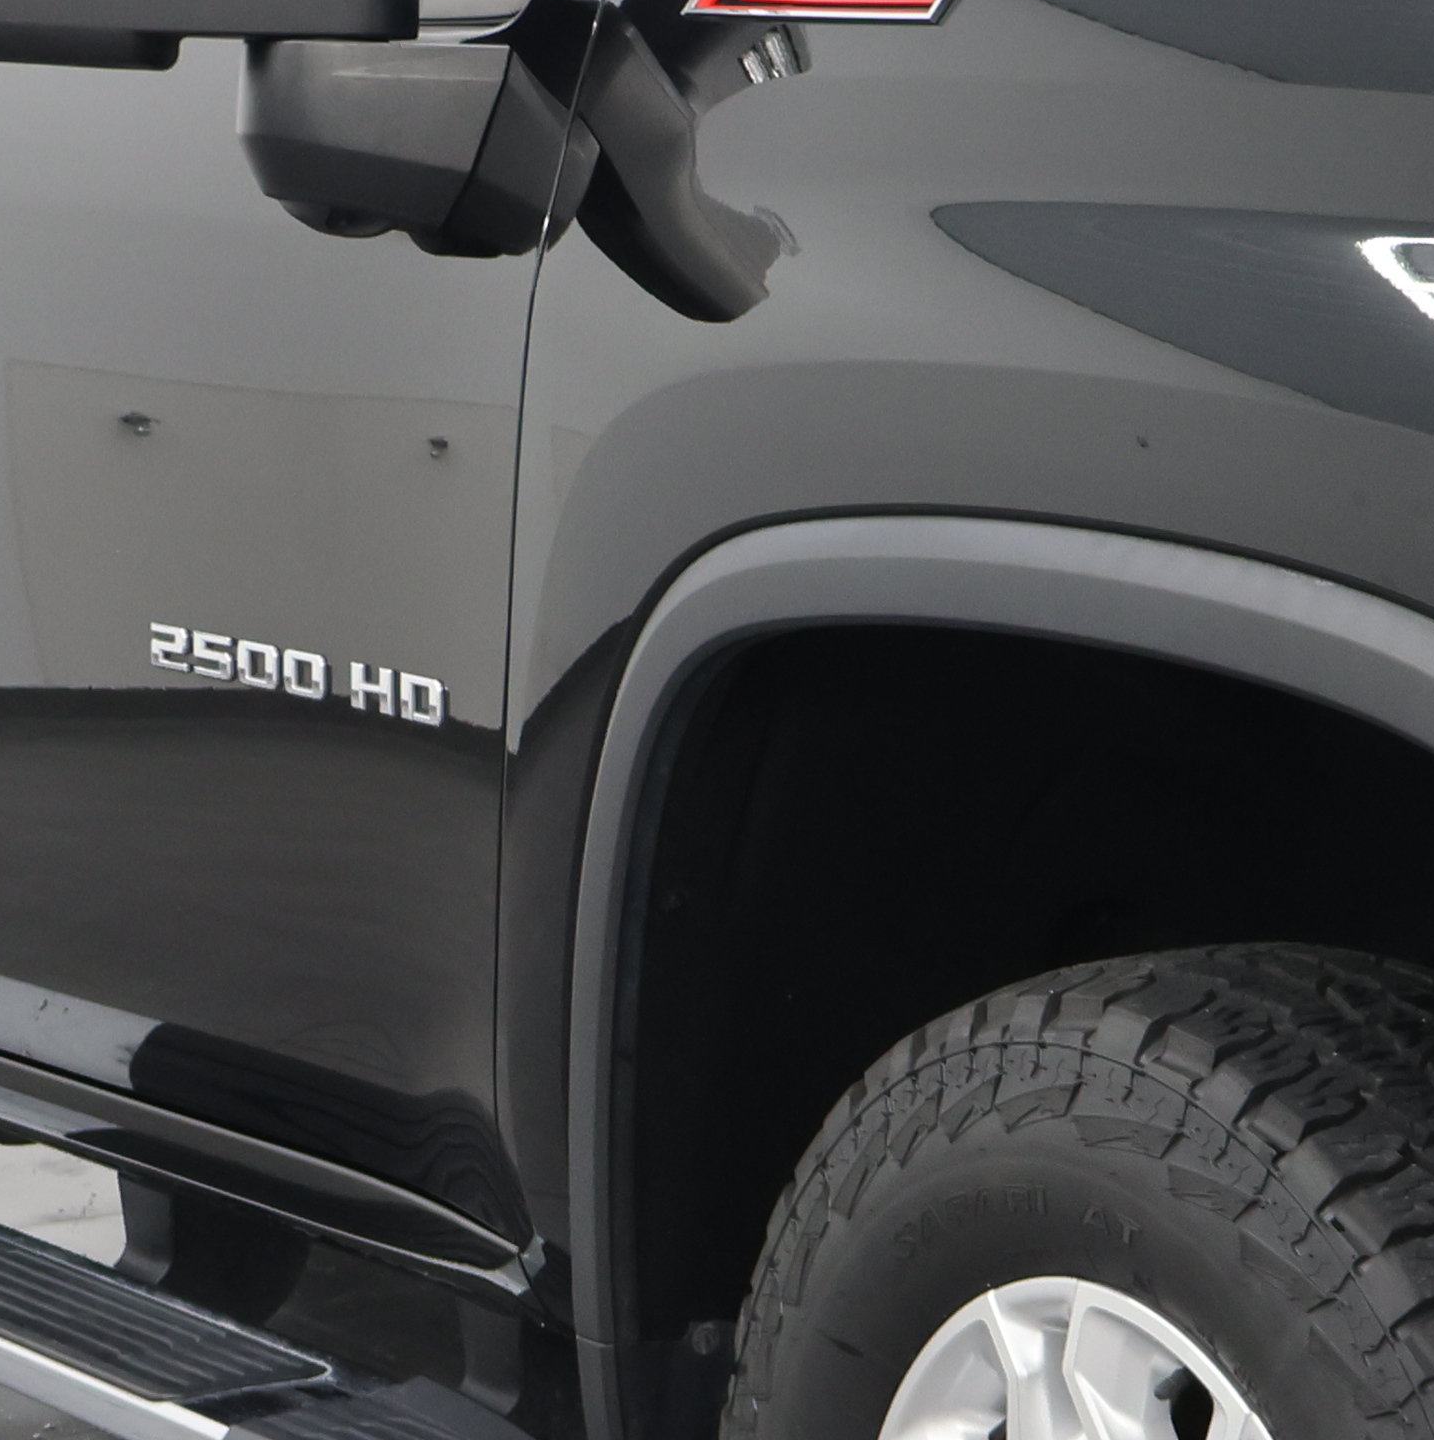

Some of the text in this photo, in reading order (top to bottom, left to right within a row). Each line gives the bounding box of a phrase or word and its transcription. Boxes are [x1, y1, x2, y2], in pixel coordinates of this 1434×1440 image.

[150, 621, 447, 728] 2500 HD
[1079, 1201, 1143, 1247] AT
